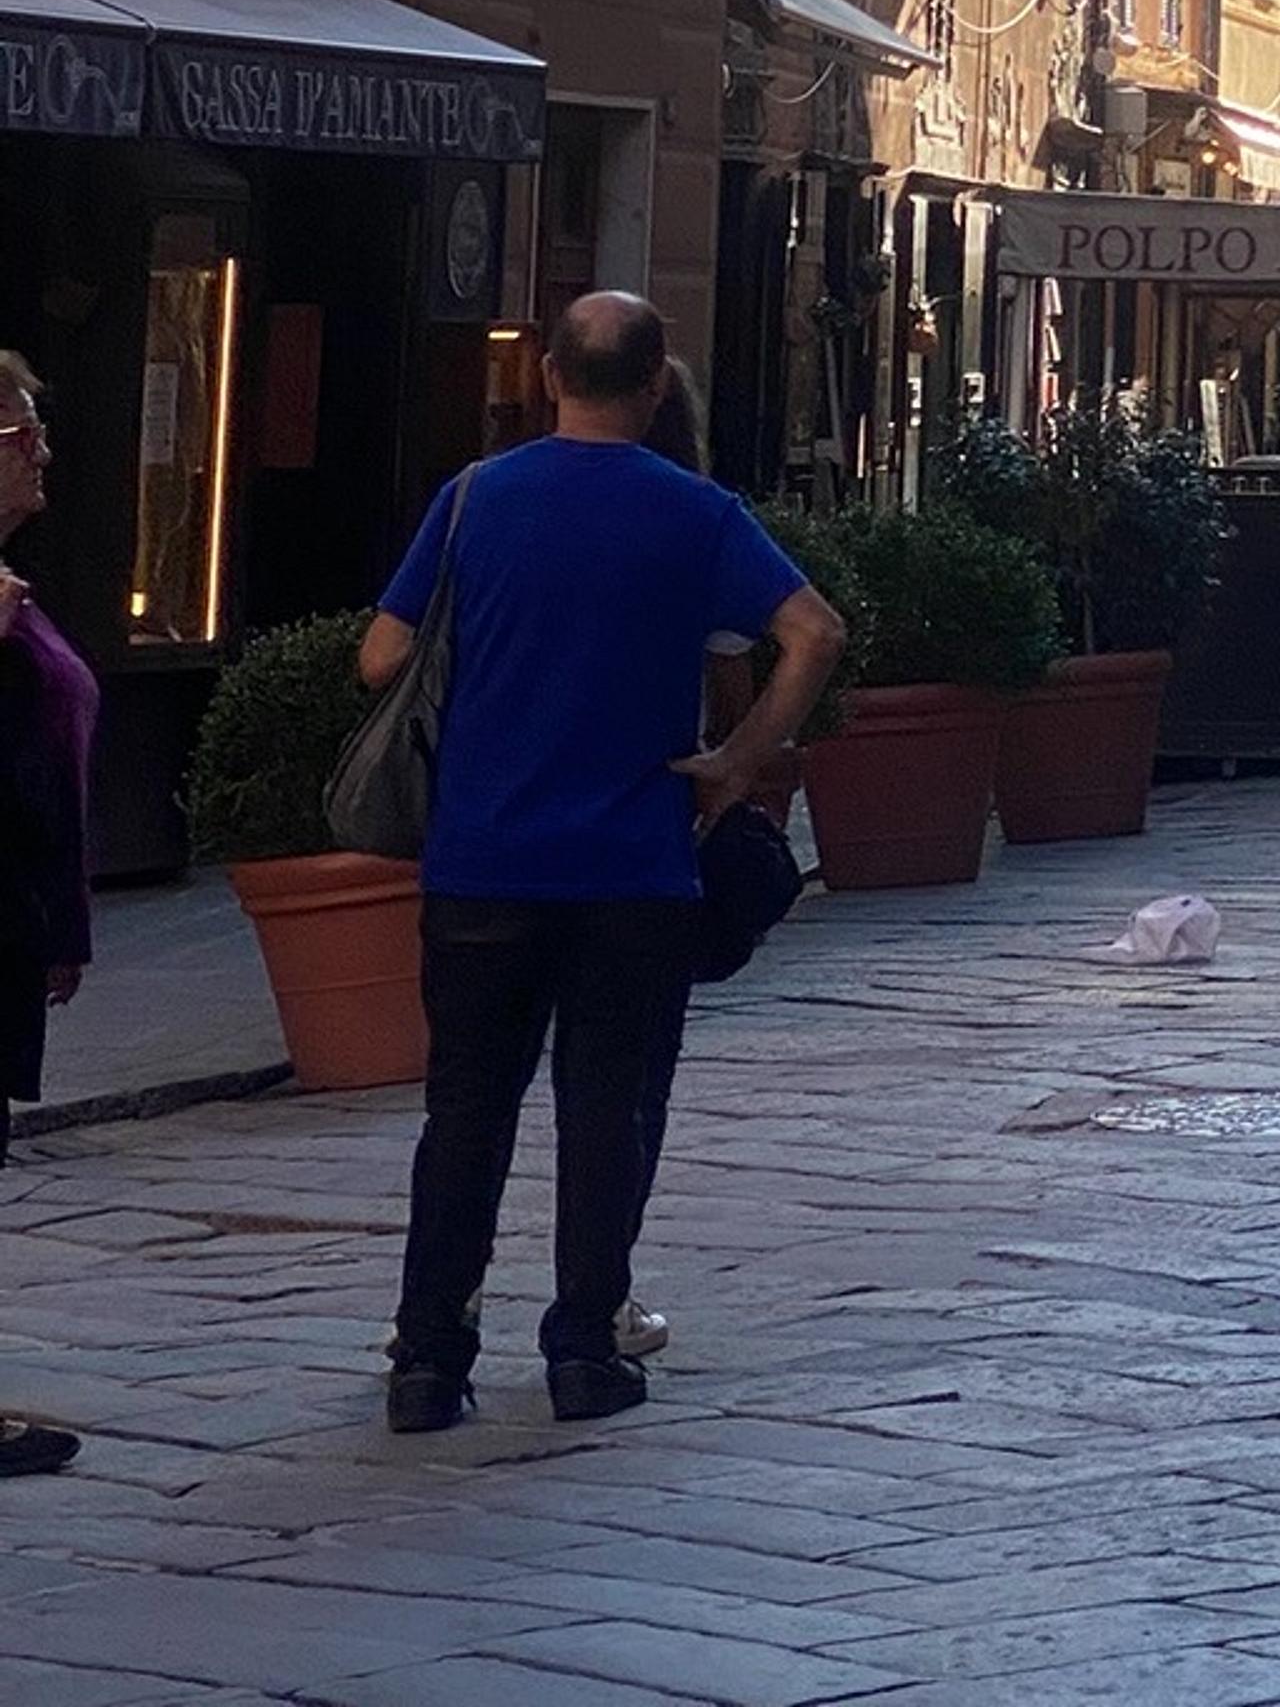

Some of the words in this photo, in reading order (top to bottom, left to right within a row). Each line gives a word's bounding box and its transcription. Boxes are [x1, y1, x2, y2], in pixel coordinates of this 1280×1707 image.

[182, 61, 283, 134] GASSA
[295, 71, 461, 147] D'AMANTE
[1057, 224, 1258, 273] POLPO
